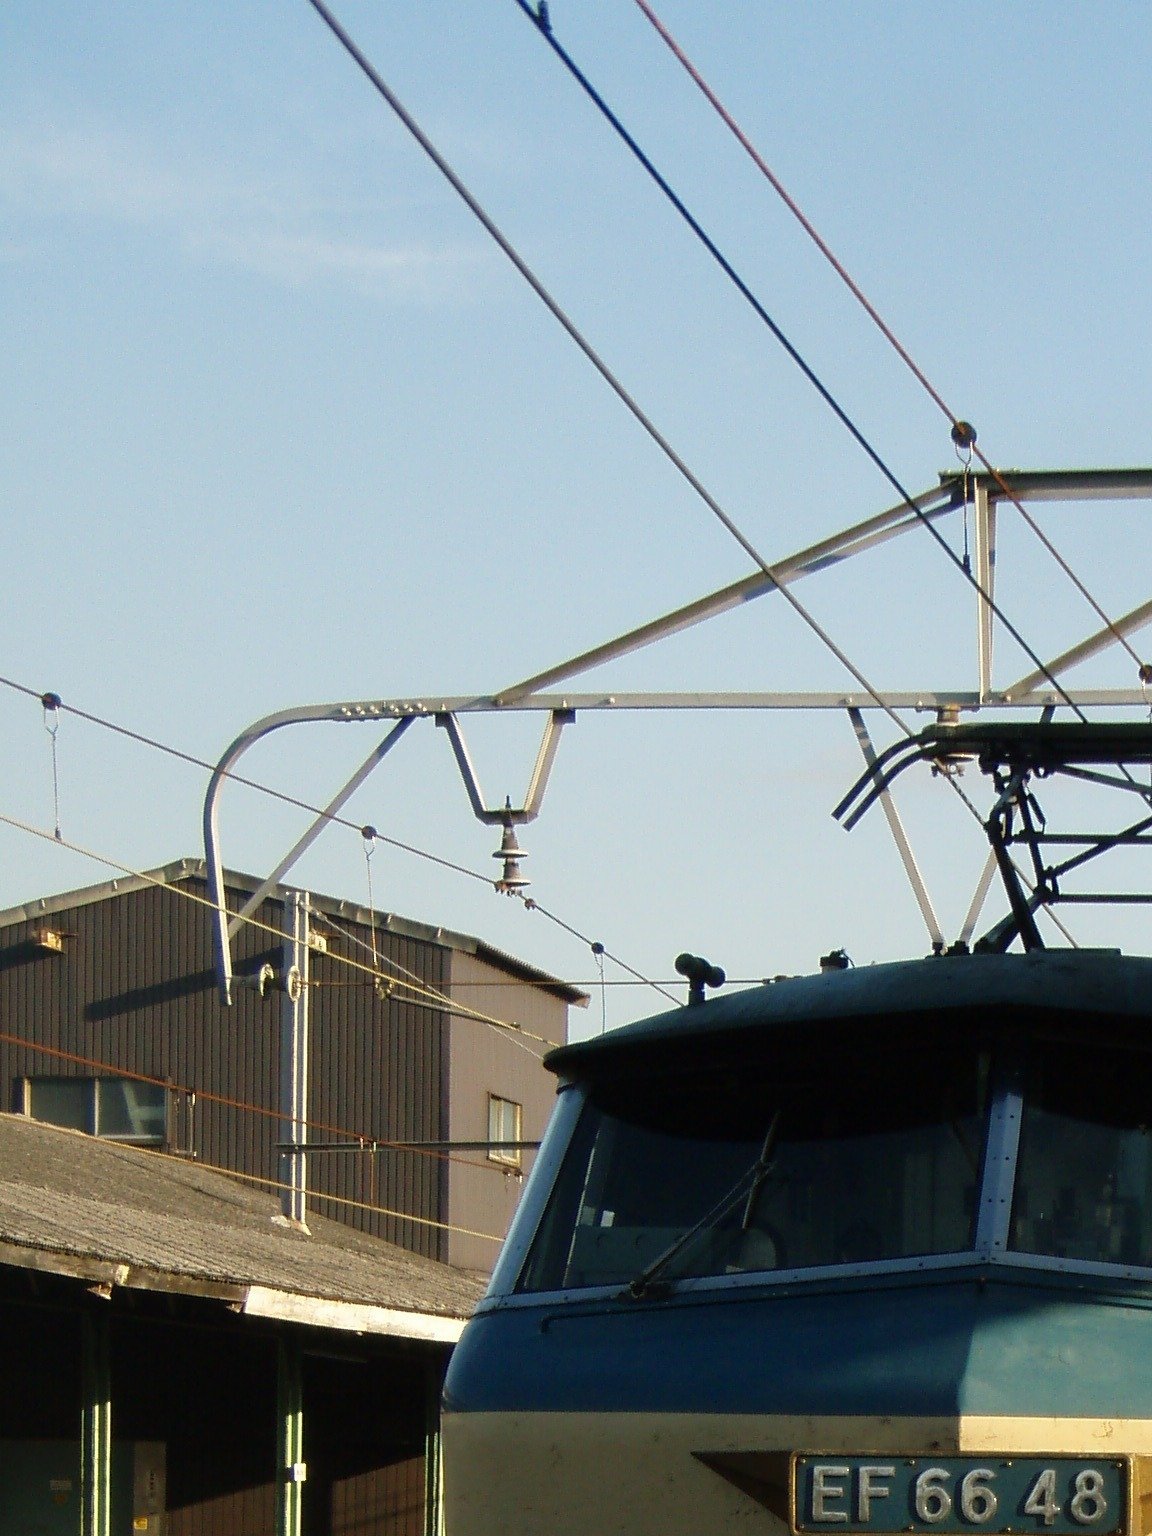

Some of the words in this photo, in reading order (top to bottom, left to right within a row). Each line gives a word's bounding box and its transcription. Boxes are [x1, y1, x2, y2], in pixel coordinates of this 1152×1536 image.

[811, 1465, 896, 1523] EF
[915, 1467, 997, 1524] 66
[1024, 1468, 1107, 1526] 48
